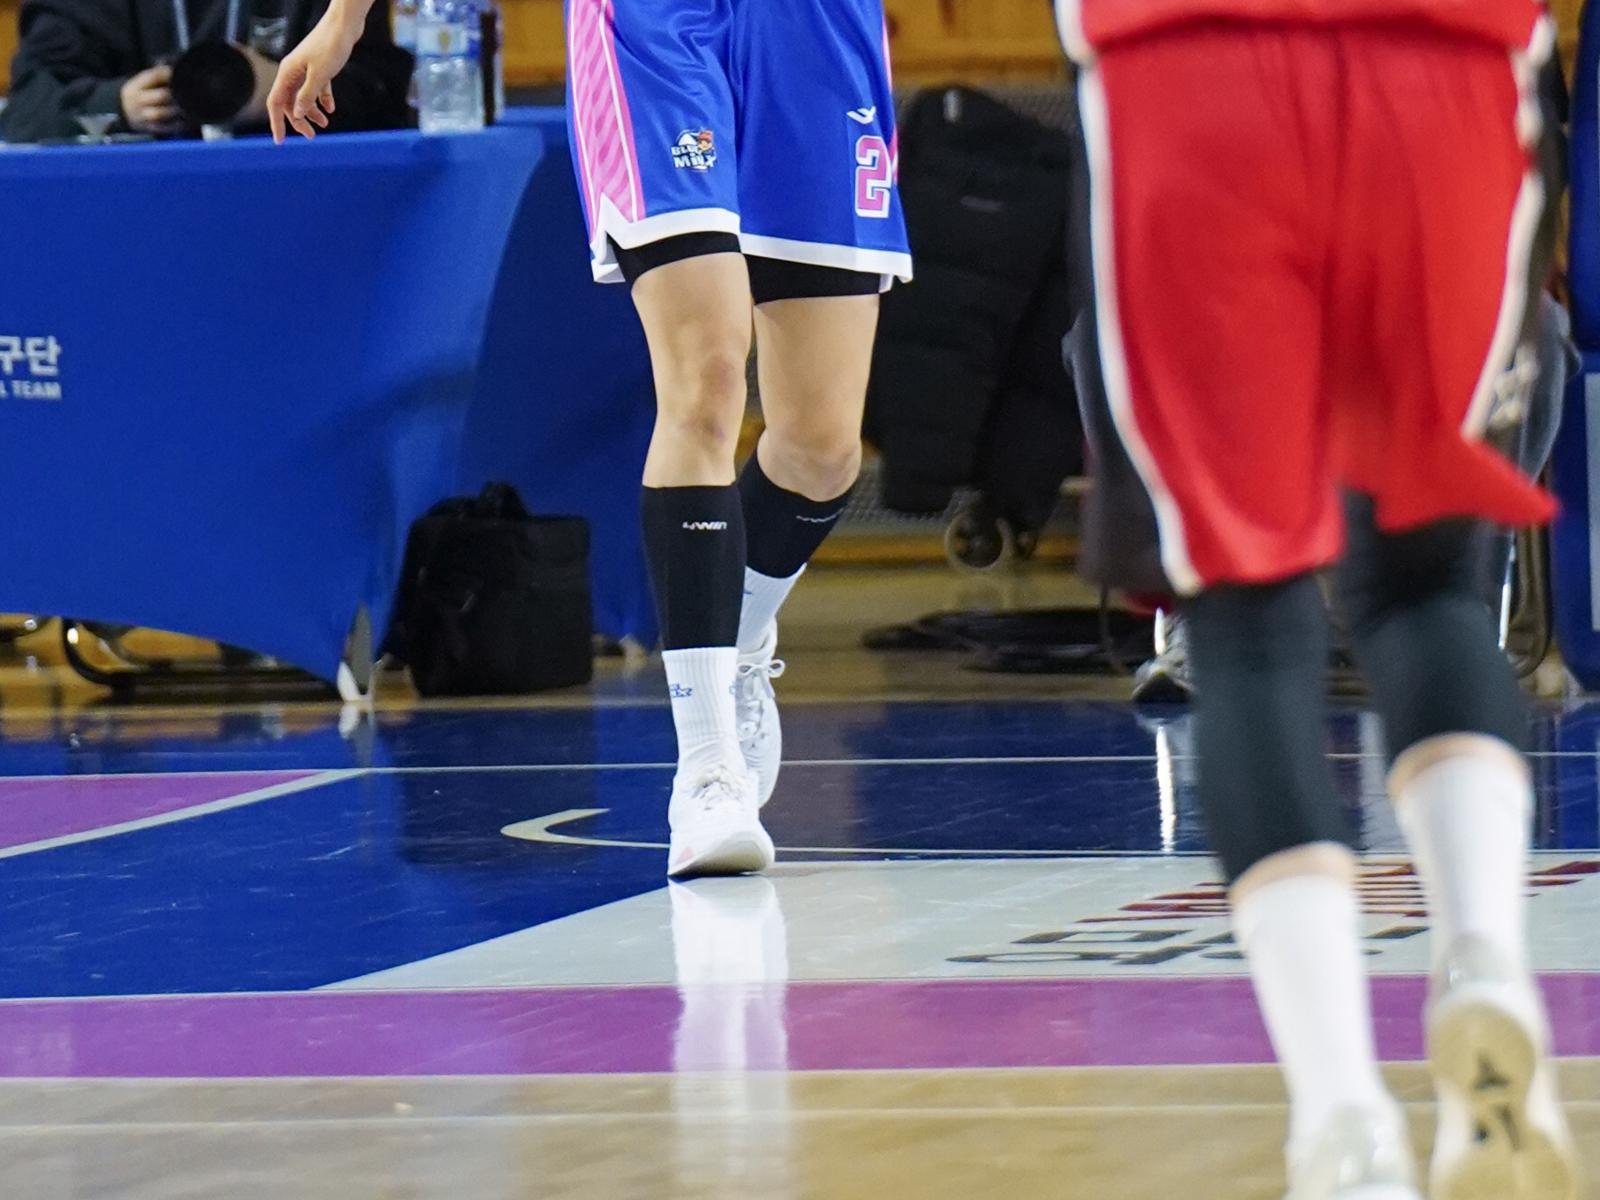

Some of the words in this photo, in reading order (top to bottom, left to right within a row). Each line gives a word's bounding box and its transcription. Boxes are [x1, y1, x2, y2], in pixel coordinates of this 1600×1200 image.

[855, 135, 892, 218] 2
[0, 335, 62, 376] 구단
[12, 380, 62, 399] TEAM
